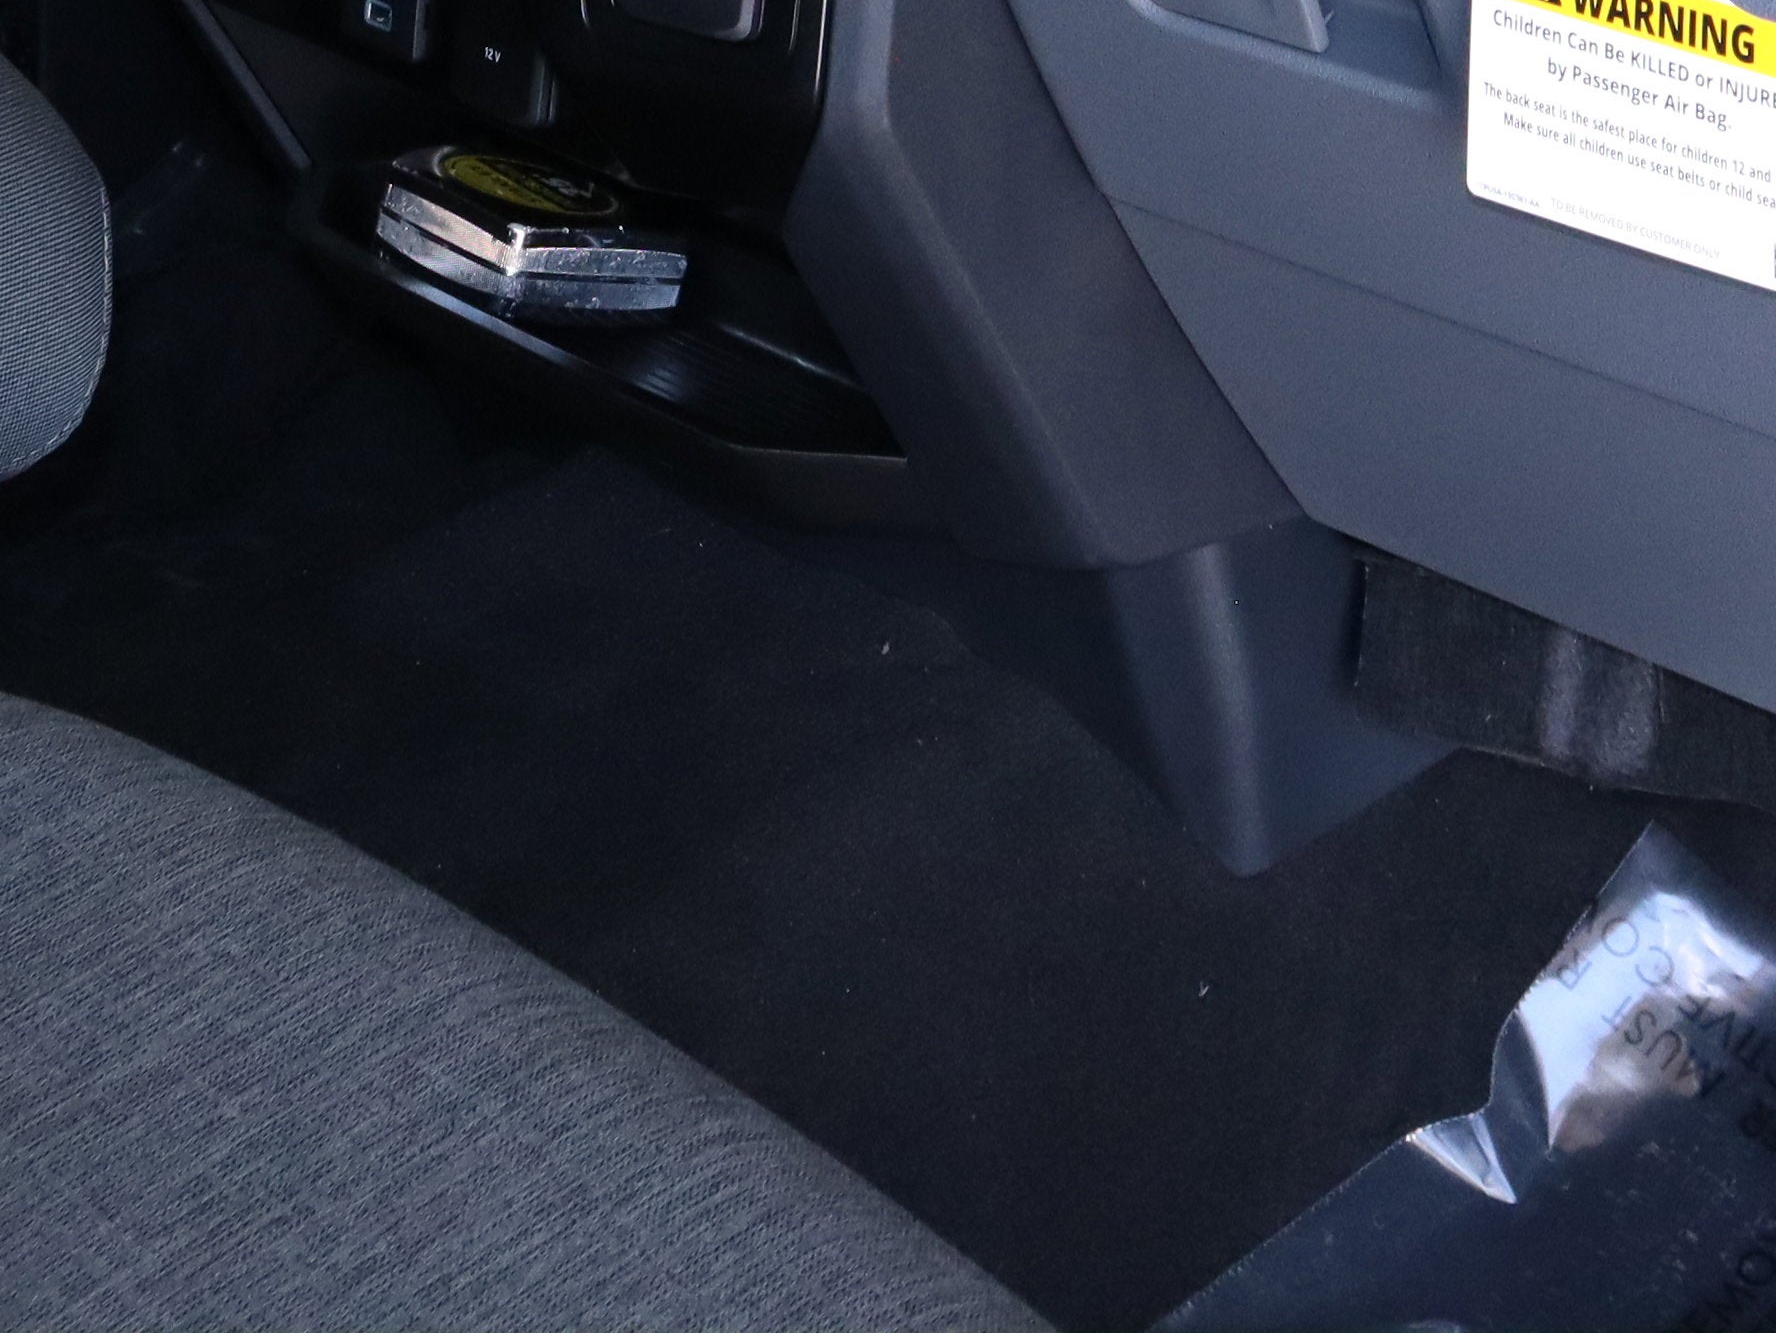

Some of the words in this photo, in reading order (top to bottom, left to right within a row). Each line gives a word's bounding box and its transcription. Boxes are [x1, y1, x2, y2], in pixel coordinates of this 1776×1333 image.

[1493, 9, 1562, 45] Children
[1567, 32, 1599, 56] Can
[1604, 42, 1625, 63] Be
[1630, 50, 1689, 82] KILLED
[1695, 73, 1714, 88] or
[1484, 81, 1503, 100] The
[1505, 88, 1530, 109] back
[1533, 99, 1556, 117] seat
[1559, 105, 1568, 121] is
[1571, 109, 1589, 127] the
[1592, 118, 1626, 140] safest
[1628, 129, 1658, 149] place
[1661, 136, 1678, 154] for
[1681, 144, 1728, 171] children
[1732, 159, 1745, 176] 12
[1749, 166, 1771, 183] and
[1547, 56, 1567, 82] by
[1572, 65, 1658, 106] Passenger
[1664, 94, 1689, 116] Air
[1695, 102, 1732, 132] Bag.
[1503, 111, 1533, 134] Make
[1536, 125, 1559, 142] sure
[1563, 131, 1576, 147] all
[1579, 137, 1624, 163] children
[1627, 153, 1647, 169] use
[1650, 161, 1674, 178] seat
[1677, 166, 1705, 188] belts
[1709, 178, 1721, 192] or
[1725, 182, 1753, 202] child
[1551, 196, 1564, 212] TO
[1565, 202, 1576, 215] BE
[1578, 205, 1624, 230] REMOVED
[1625, 220, 1639, 234] BY
[1639, 225, 1692, 252] CUSTOMER
[1693, 243, 1721, 260] ONLY
